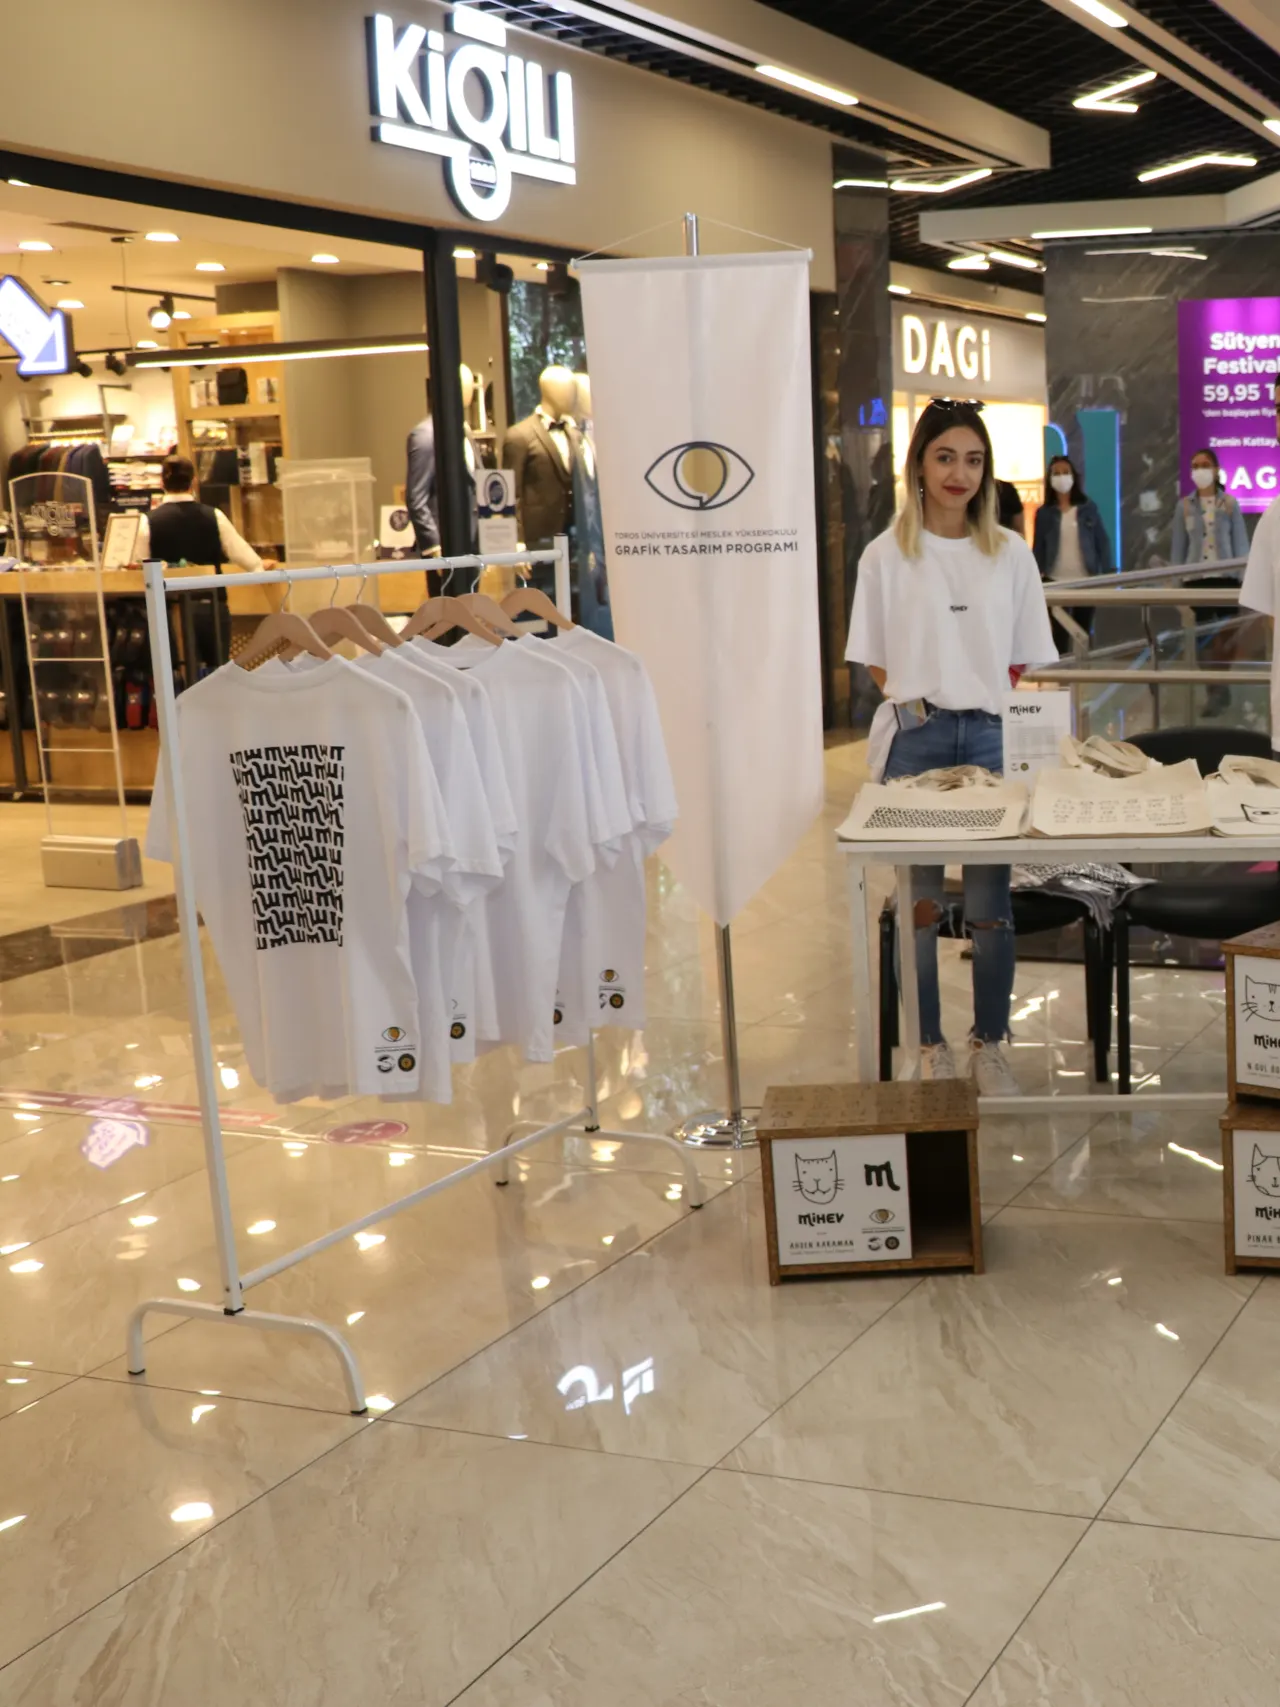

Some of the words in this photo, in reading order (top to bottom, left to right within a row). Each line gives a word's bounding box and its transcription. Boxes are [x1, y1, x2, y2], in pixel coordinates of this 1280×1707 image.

[1203, 384, 1260, 404] 59,95
[1209, 437, 1241, 447] Zemin
[642, 531, 699, 539] ÜNİVERSİTESİ
[701, 530, 733, 538] MESLEK
[615, 543, 660, 556] GRAFİK
[665, 543, 722, 555] TASARIM
[727, 542, 798, 553] PROGRAMI
